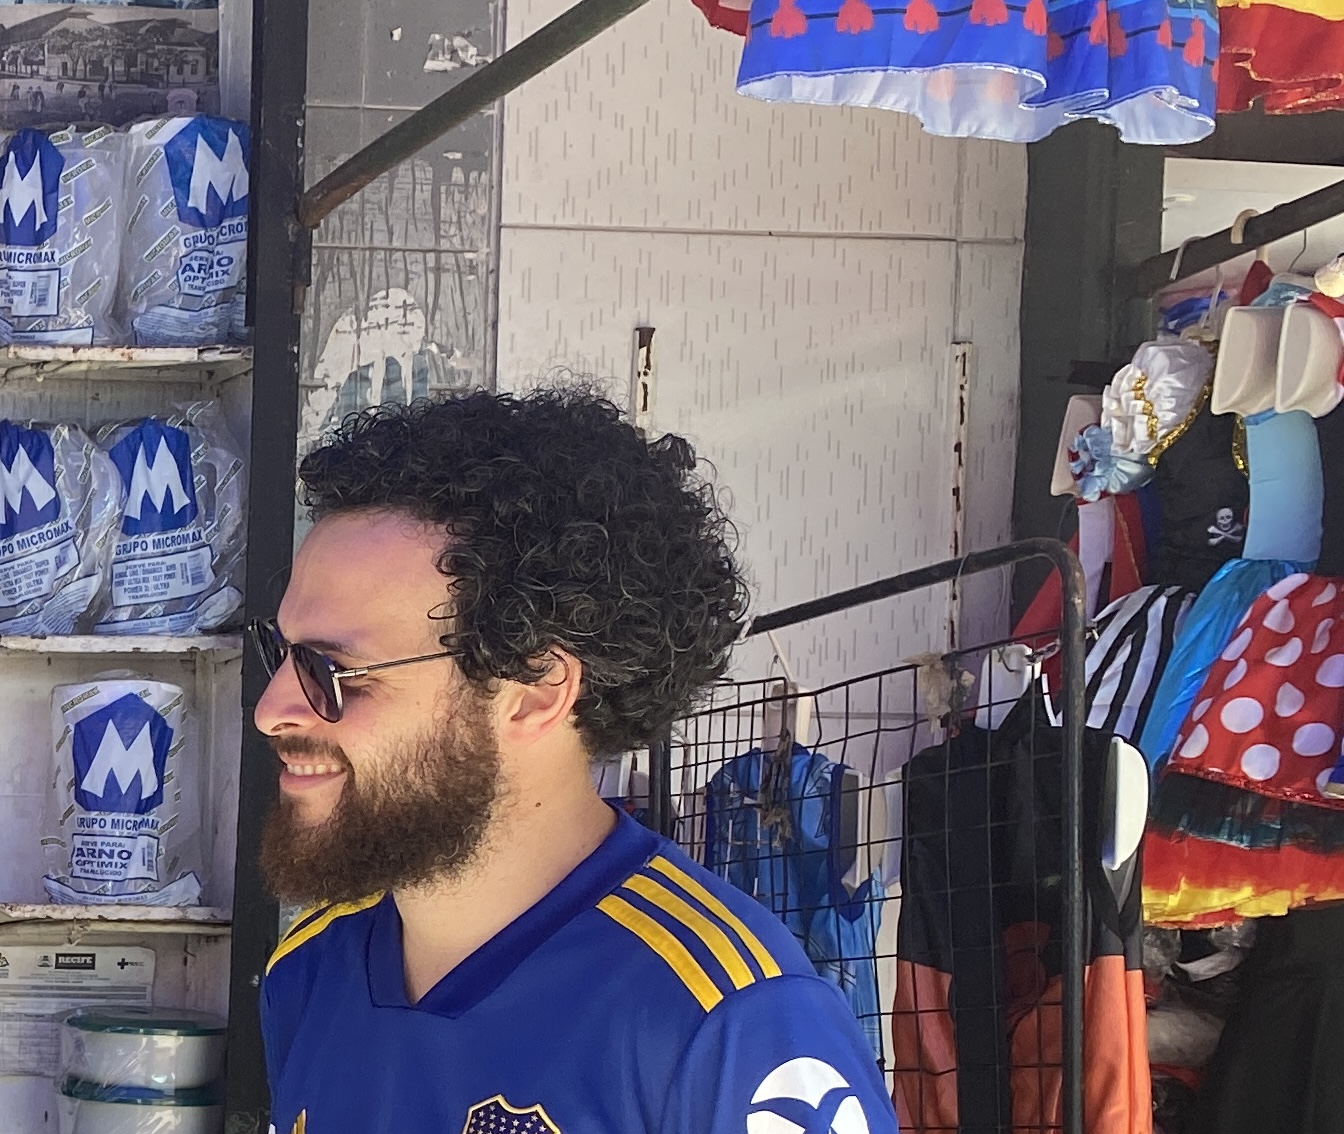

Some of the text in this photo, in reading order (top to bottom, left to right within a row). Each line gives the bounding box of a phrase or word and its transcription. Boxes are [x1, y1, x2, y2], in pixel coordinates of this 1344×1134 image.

[16, 519, 73, 551] MICROMAX
[152, 528, 203, 550] MICROMAX
[75, 847, 132, 860] ARNO
[75, 859, 128, 870] OPTIMIX
[58, 955, 93, 965] RECIFE
